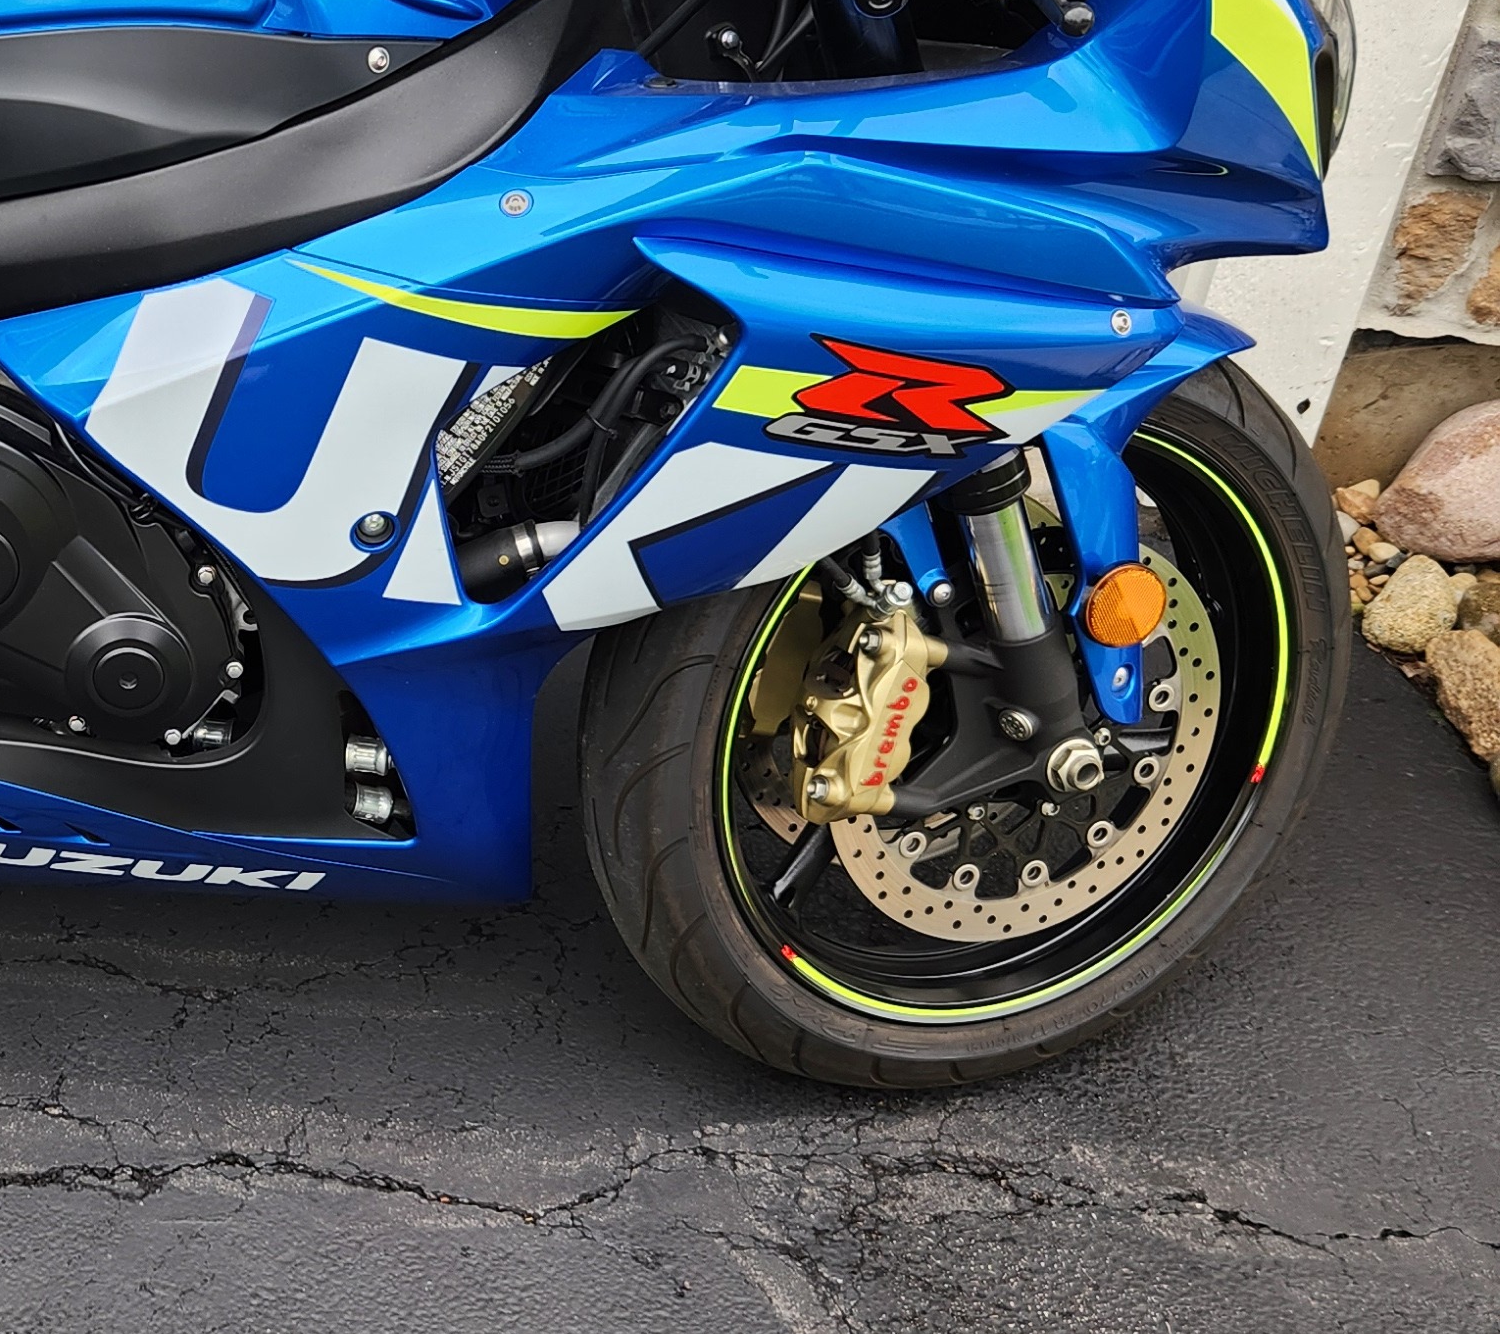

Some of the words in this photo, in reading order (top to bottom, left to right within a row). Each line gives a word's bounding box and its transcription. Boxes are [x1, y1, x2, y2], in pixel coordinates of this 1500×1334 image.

[765, 414, 990, 455] GSX
[797, 338, 1006, 433] R
[1211, 421, 1326, 618] MICHELIN
[860, 676, 918, 787] brembo
